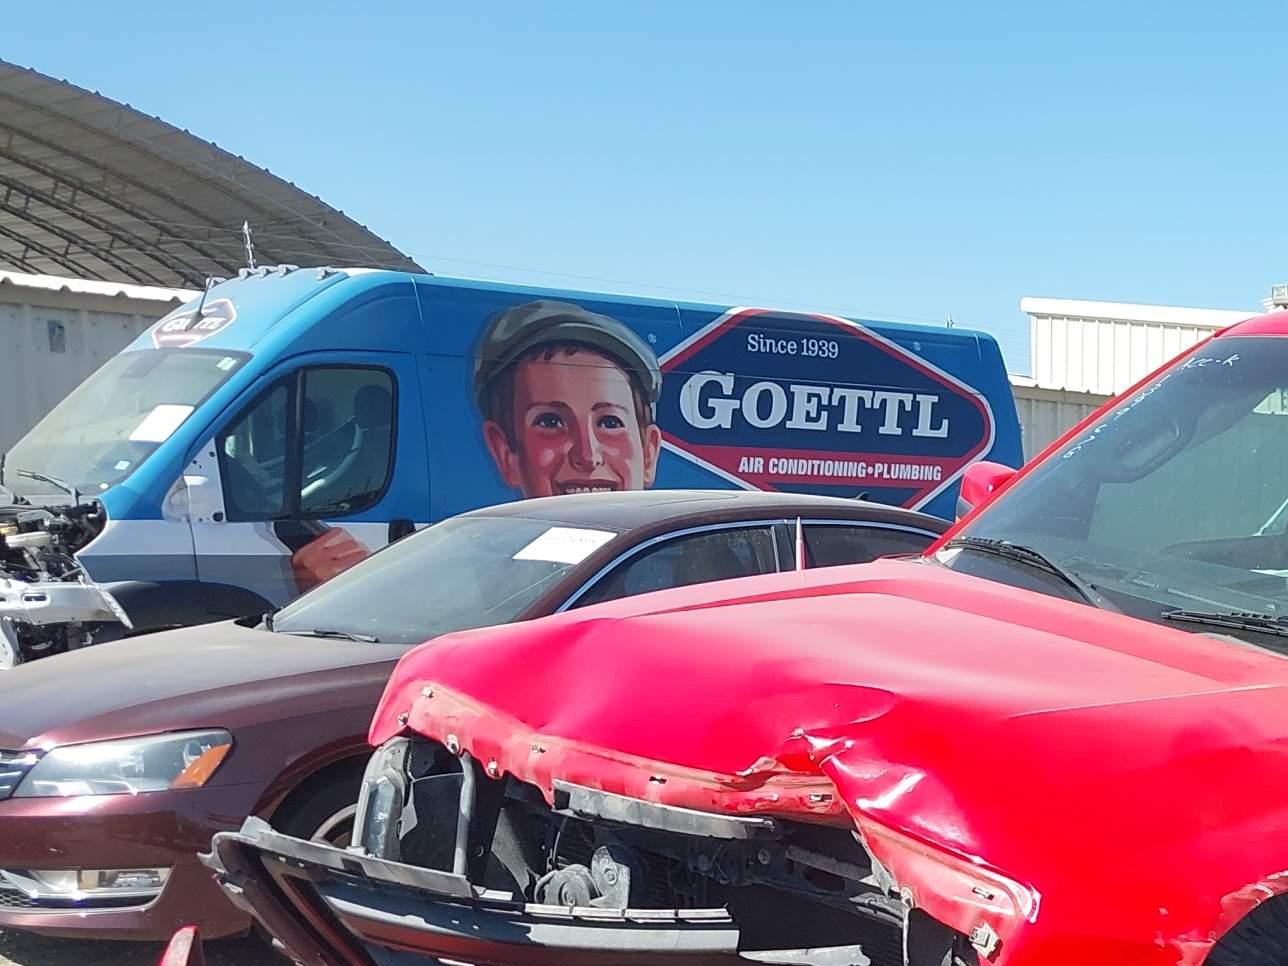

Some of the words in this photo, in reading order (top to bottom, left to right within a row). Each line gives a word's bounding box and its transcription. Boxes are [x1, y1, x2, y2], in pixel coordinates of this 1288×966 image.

[747, 334, 797, 355] Since
[801, 338, 839, 359] 1939
[679, 370, 949, 439] GOETTL
[738, 456, 764, 474] AIR
[768, 457, 867, 478] CONDITIONING
[873, 463, 942, 481] PLUMBING
